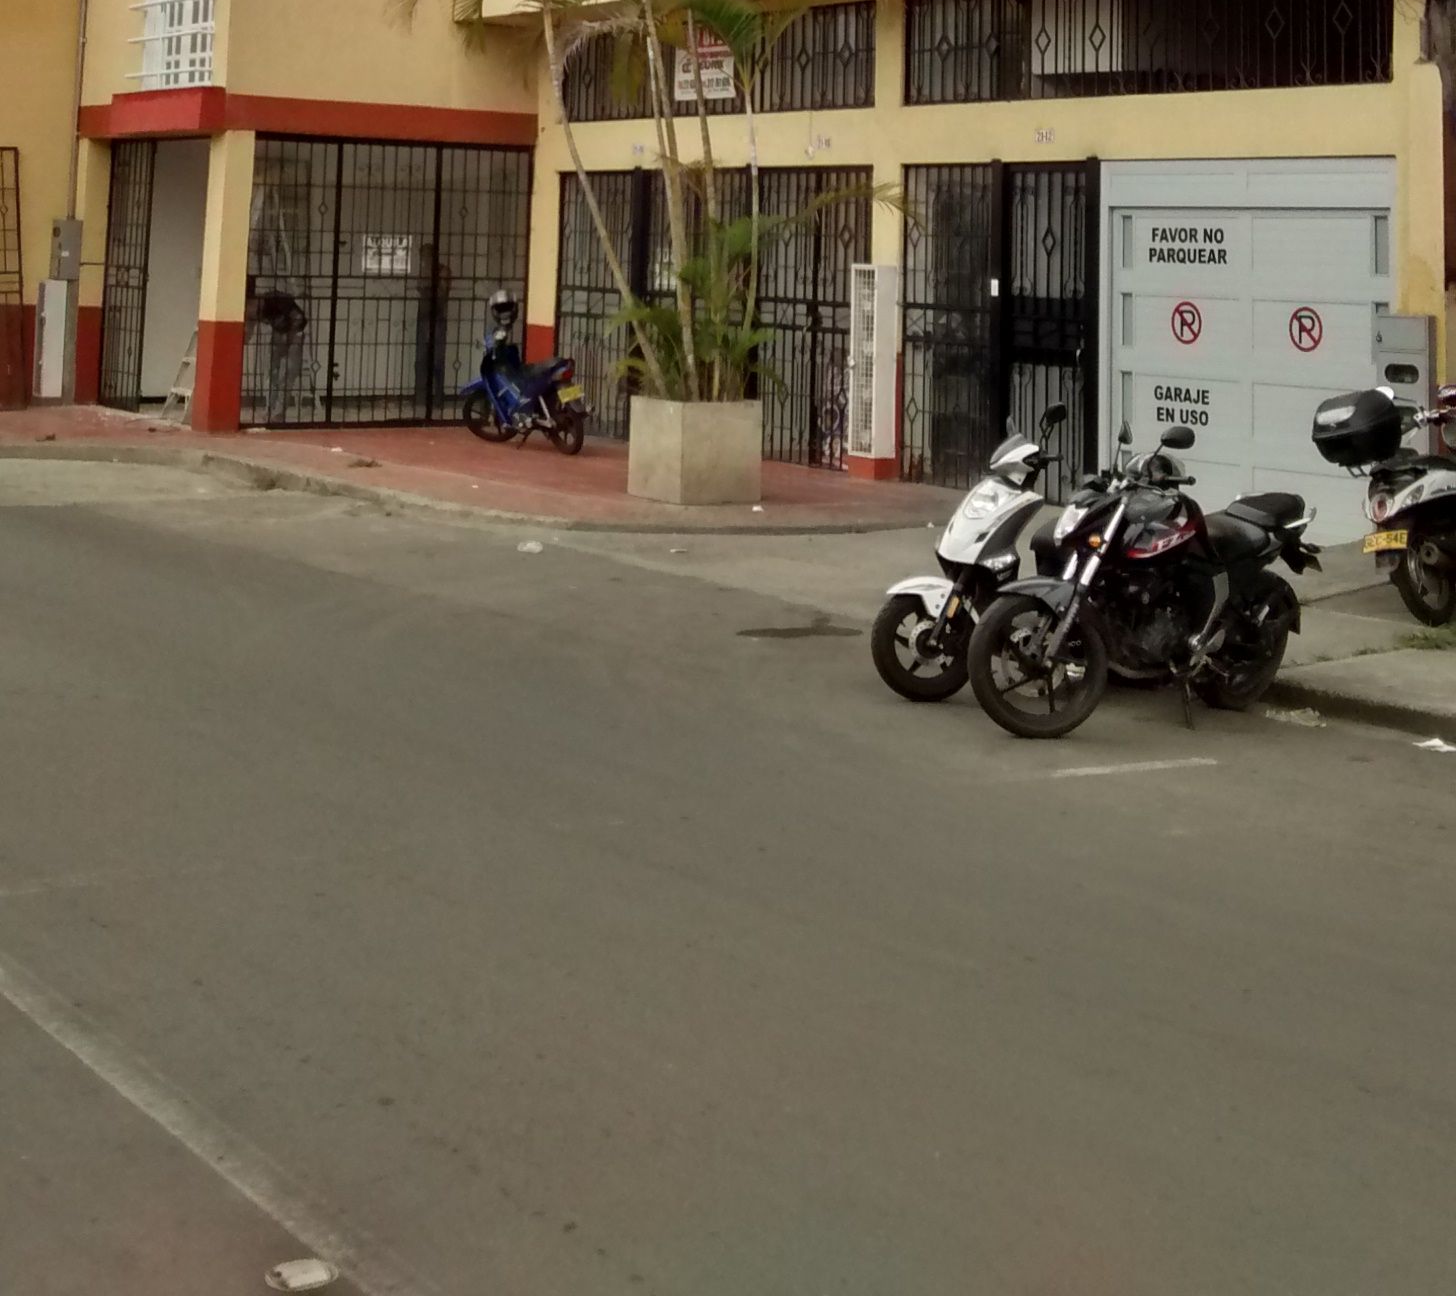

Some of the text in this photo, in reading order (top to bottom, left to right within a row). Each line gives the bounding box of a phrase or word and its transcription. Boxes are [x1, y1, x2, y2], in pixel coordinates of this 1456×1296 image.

[1151, 227, 1225, 245] FAVOR NO
[1149, 248, 1227, 264] PARQUEAR
[1154, 386, 1210, 405] GARAJE
[1156, 406, 1209, 426] EN USO
